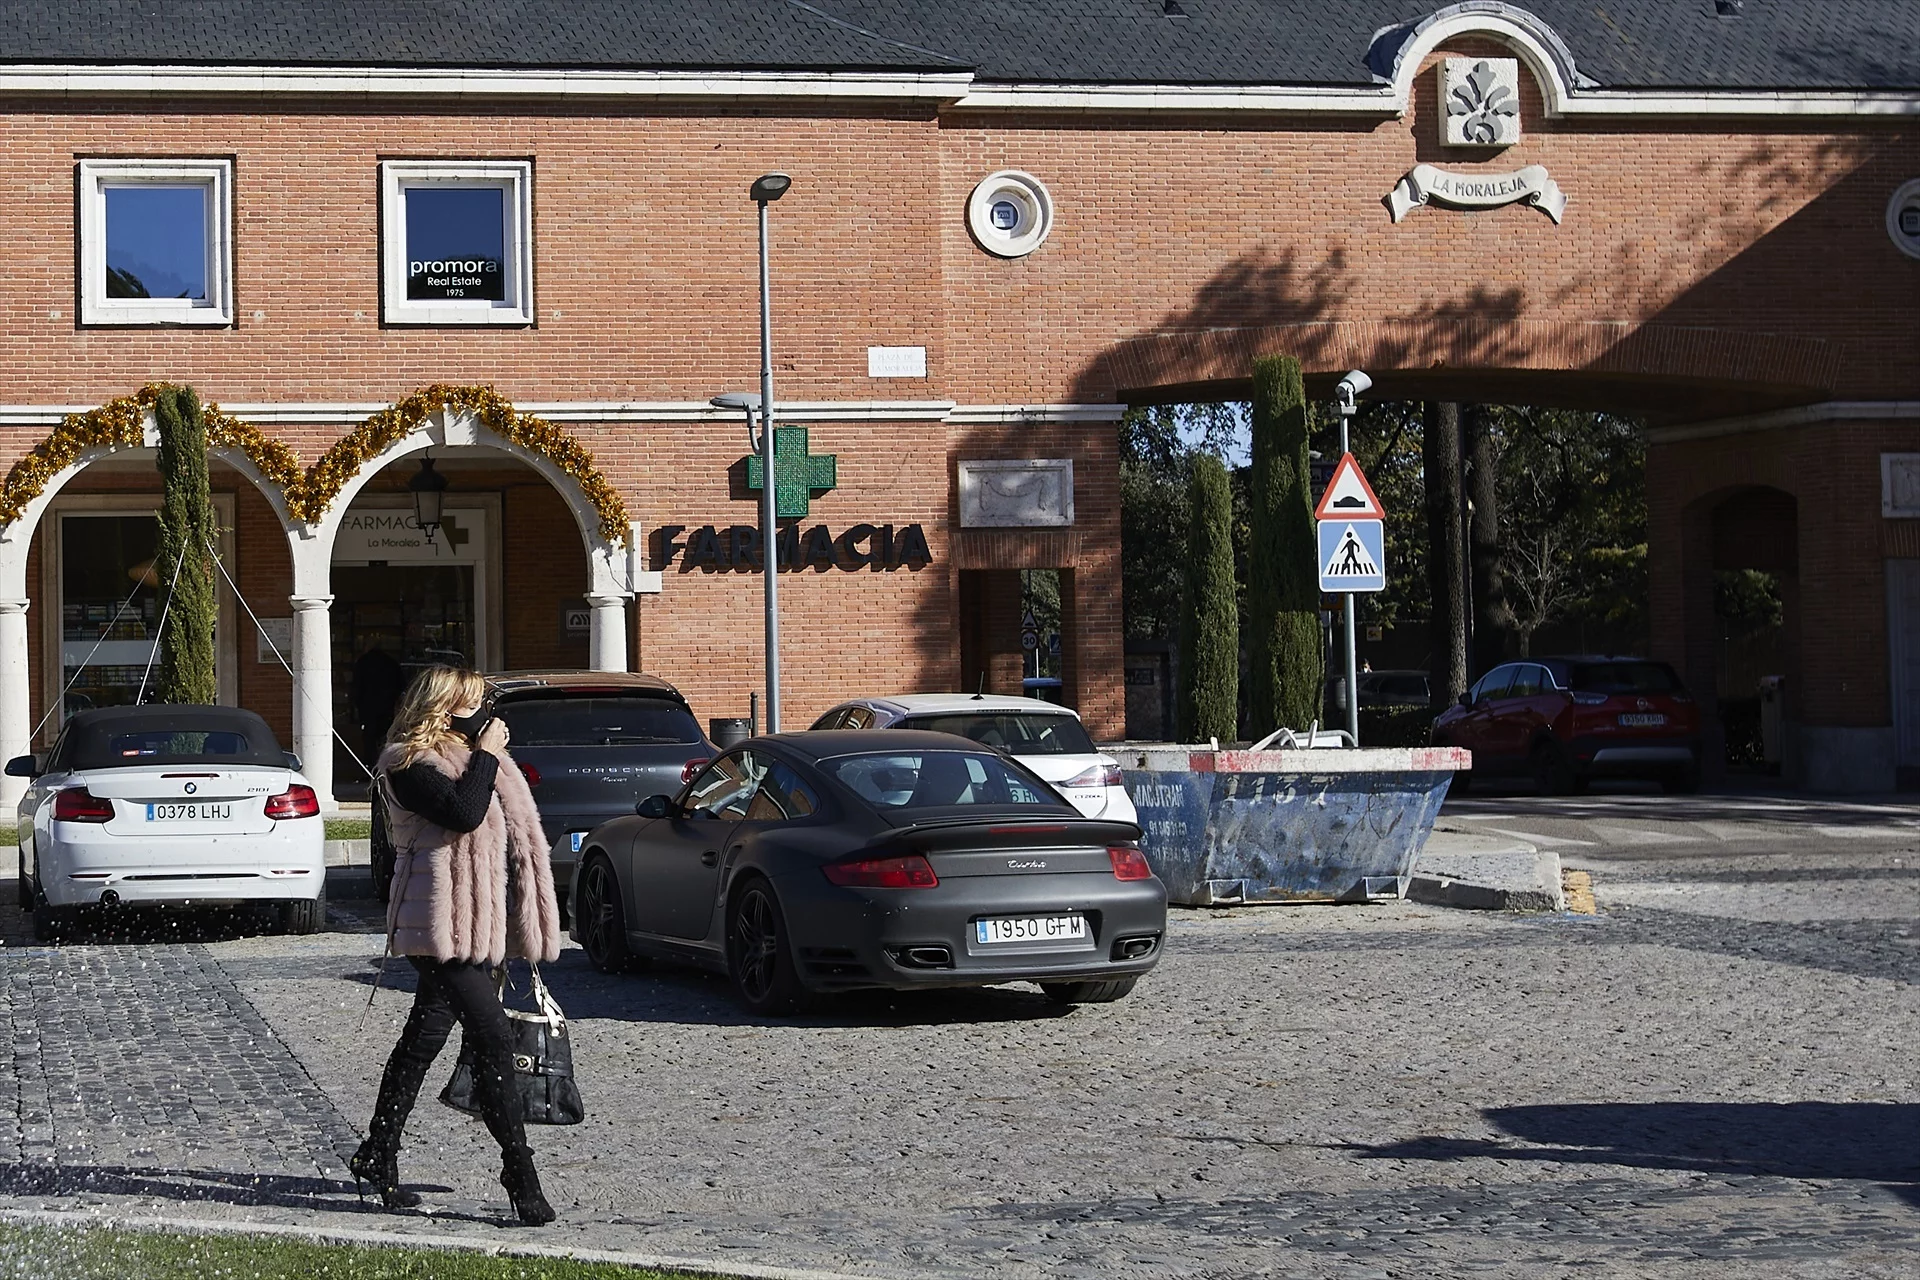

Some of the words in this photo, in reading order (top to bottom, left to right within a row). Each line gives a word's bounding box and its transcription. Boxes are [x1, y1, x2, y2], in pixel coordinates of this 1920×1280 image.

[1432, 175, 1449, 193] LA
[1455, 177, 1527, 197] MORALEJA
[410, 260, 497, 277] promora
[427, 277, 450, 286] Real
[452, 277, 482, 286] Estate
[446, 289, 464, 297] 1975
[342, 516, 418, 530] FARMAC
[367, 539, 379, 548] La
[382, 538, 421, 548] Moraleja
[660, 523, 934, 567] FARMACIA
[1023, 636, 1036, 646] 30
[157, 805, 197, 819] 0378
[201, 805, 231, 819] LHJ
[992, 919, 1038, 939] 1950
[1045, 916, 1081, 935] GFM
